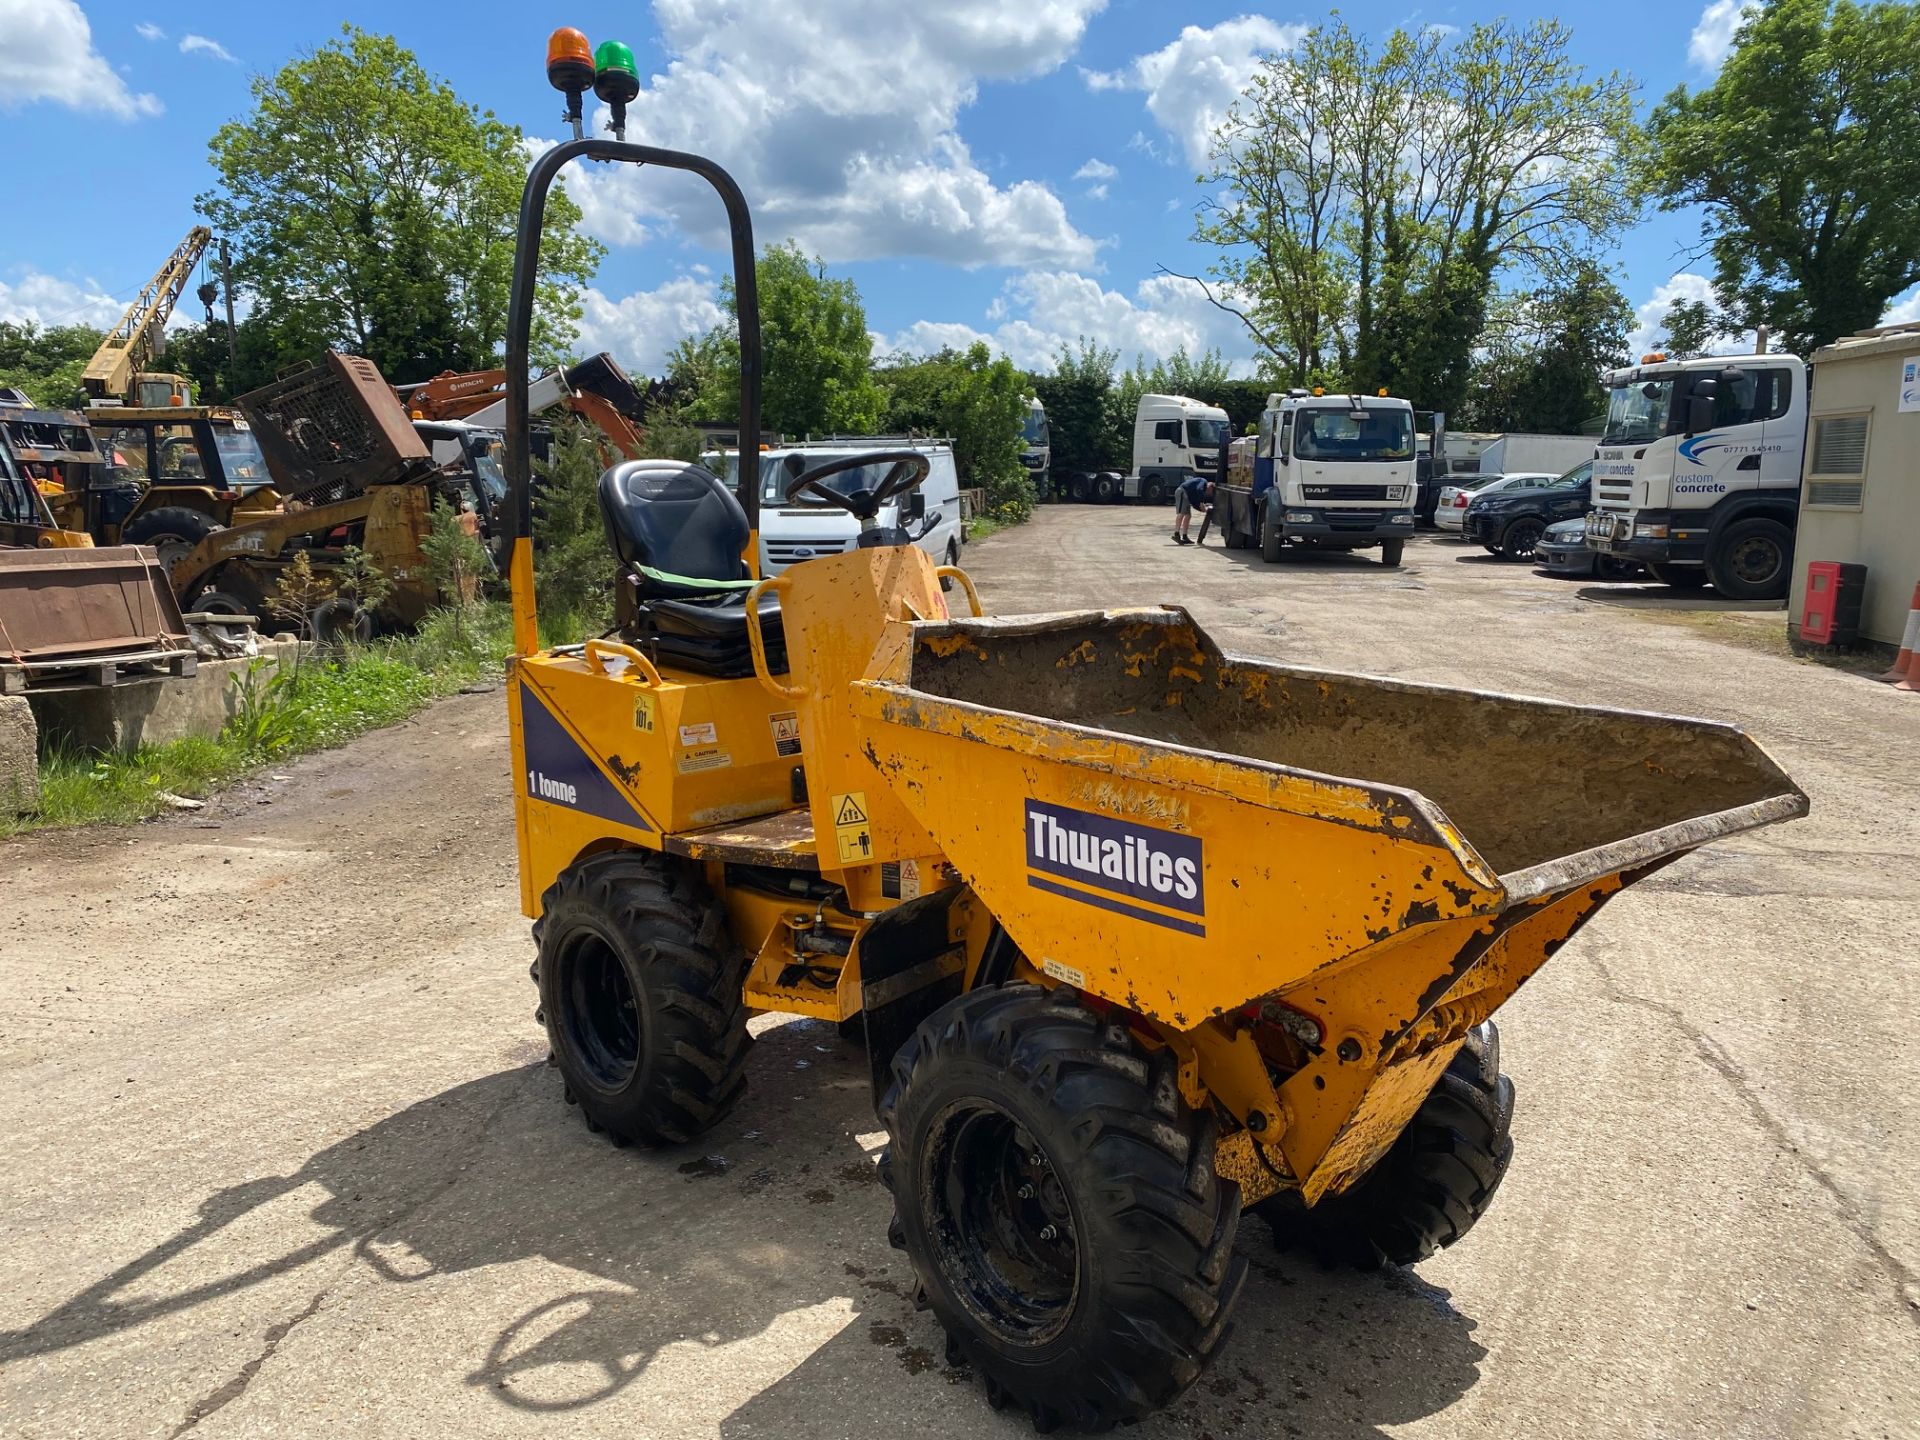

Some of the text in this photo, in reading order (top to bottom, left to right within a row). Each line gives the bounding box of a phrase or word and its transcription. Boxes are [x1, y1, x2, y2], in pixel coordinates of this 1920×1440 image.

[457, 379, 484, 389] HITACHI
[1675, 473, 1714, 483] custom
[1675, 483, 1726, 493] concrete
[635, 708, 647, 729] 101
[694, 749, 718, 757] CAUTION
[528, 769, 577, 804] 1 tonne
[1029, 811, 1198, 900] Thwaites
